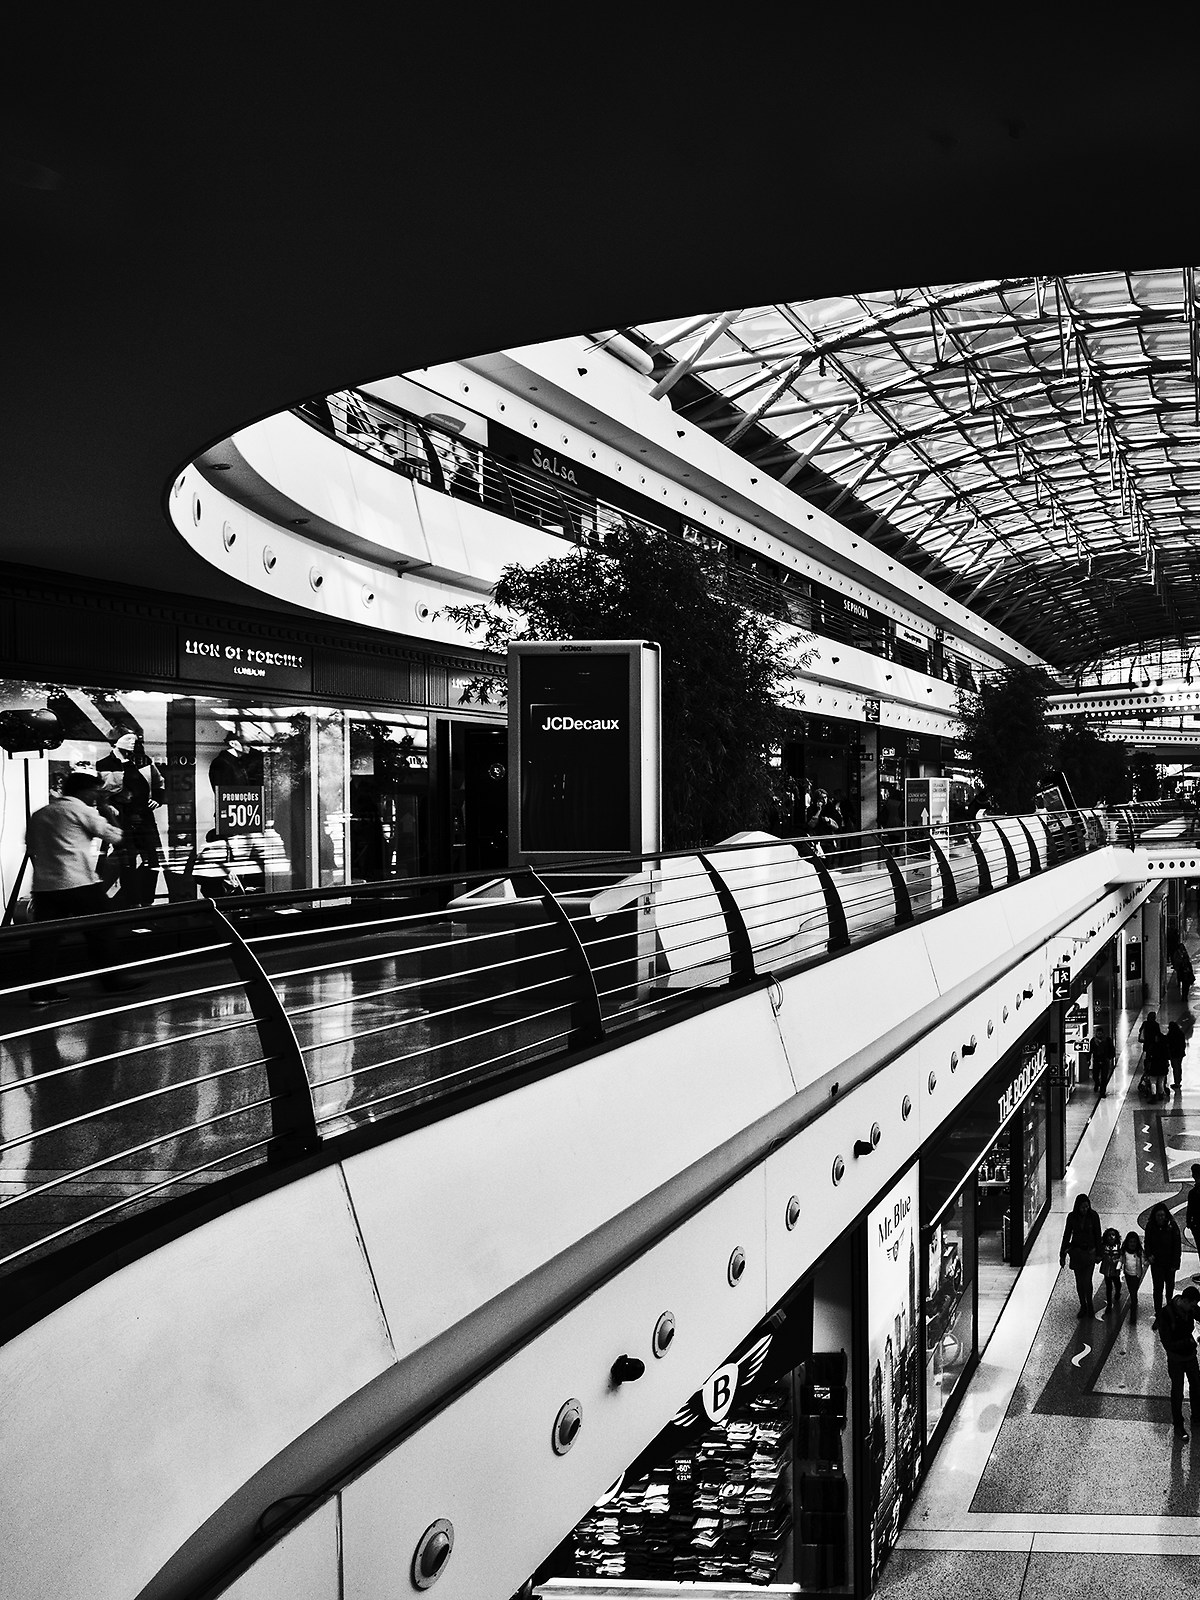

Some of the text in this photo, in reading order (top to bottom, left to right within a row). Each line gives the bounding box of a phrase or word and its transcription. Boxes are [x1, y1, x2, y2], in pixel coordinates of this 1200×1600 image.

[532, 448, 578, 485] Salsa
[843, 599, 869, 620] SEPHORA
[541, 716, 620, 731] JCDecaux
[222, 792, 259, 803] PROMOÇÕES
[998, 1044, 1047, 1123] THE BODY SHOP
[879, 1216, 893, 1248] Mr.
[894, 1196, 911, 1228] Blue
[713, 1374, 731, 1413] B
